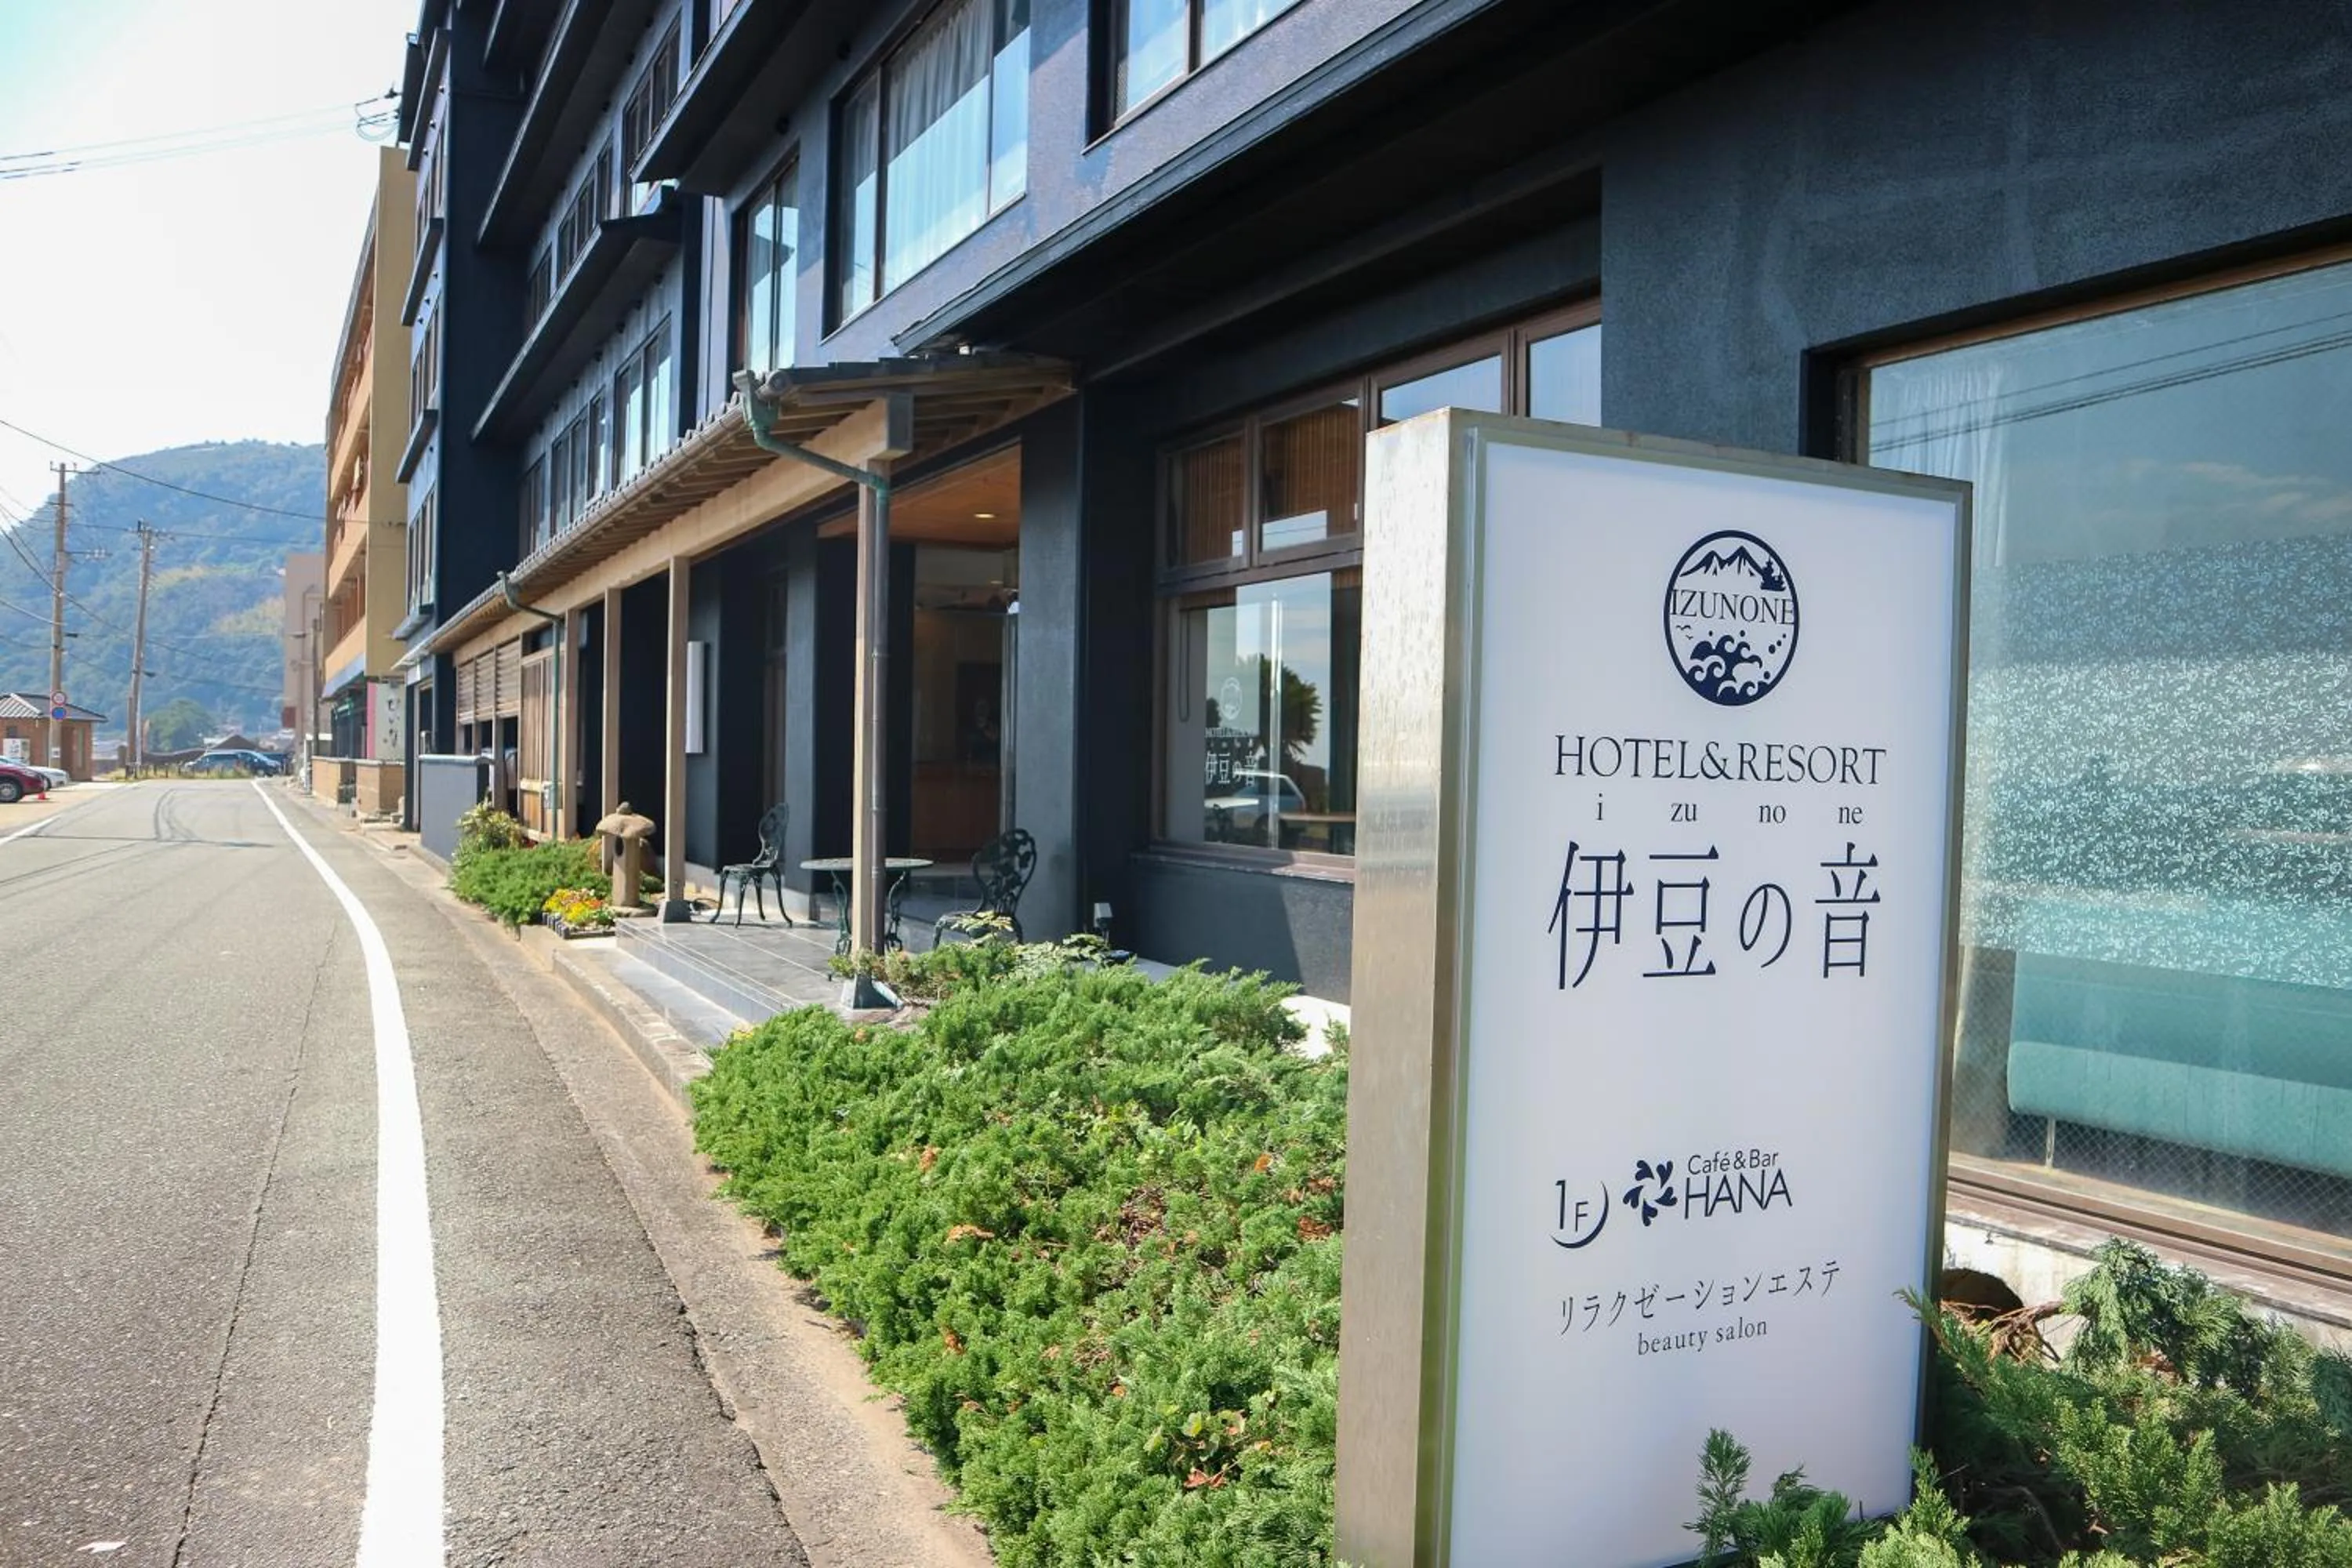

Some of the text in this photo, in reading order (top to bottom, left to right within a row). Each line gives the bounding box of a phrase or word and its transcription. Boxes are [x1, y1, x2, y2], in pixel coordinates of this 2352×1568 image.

[1671, 590, 1795, 625] IZUNONE
[1555, 735, 1887, 785] HOTEL&RESORT
[1596, 793, 1864, 825] i zu no ne
[1548, 840, 1881, 989] 伊豆の音
[1554, 1179, 1590, 1233] 1F
[1684, 1167, 1793, 1220] HANA
[1560, 1259, 1842, 1338] リラクゼーションエステ
[1637, 1316, 1768, 1356] beauty salon
